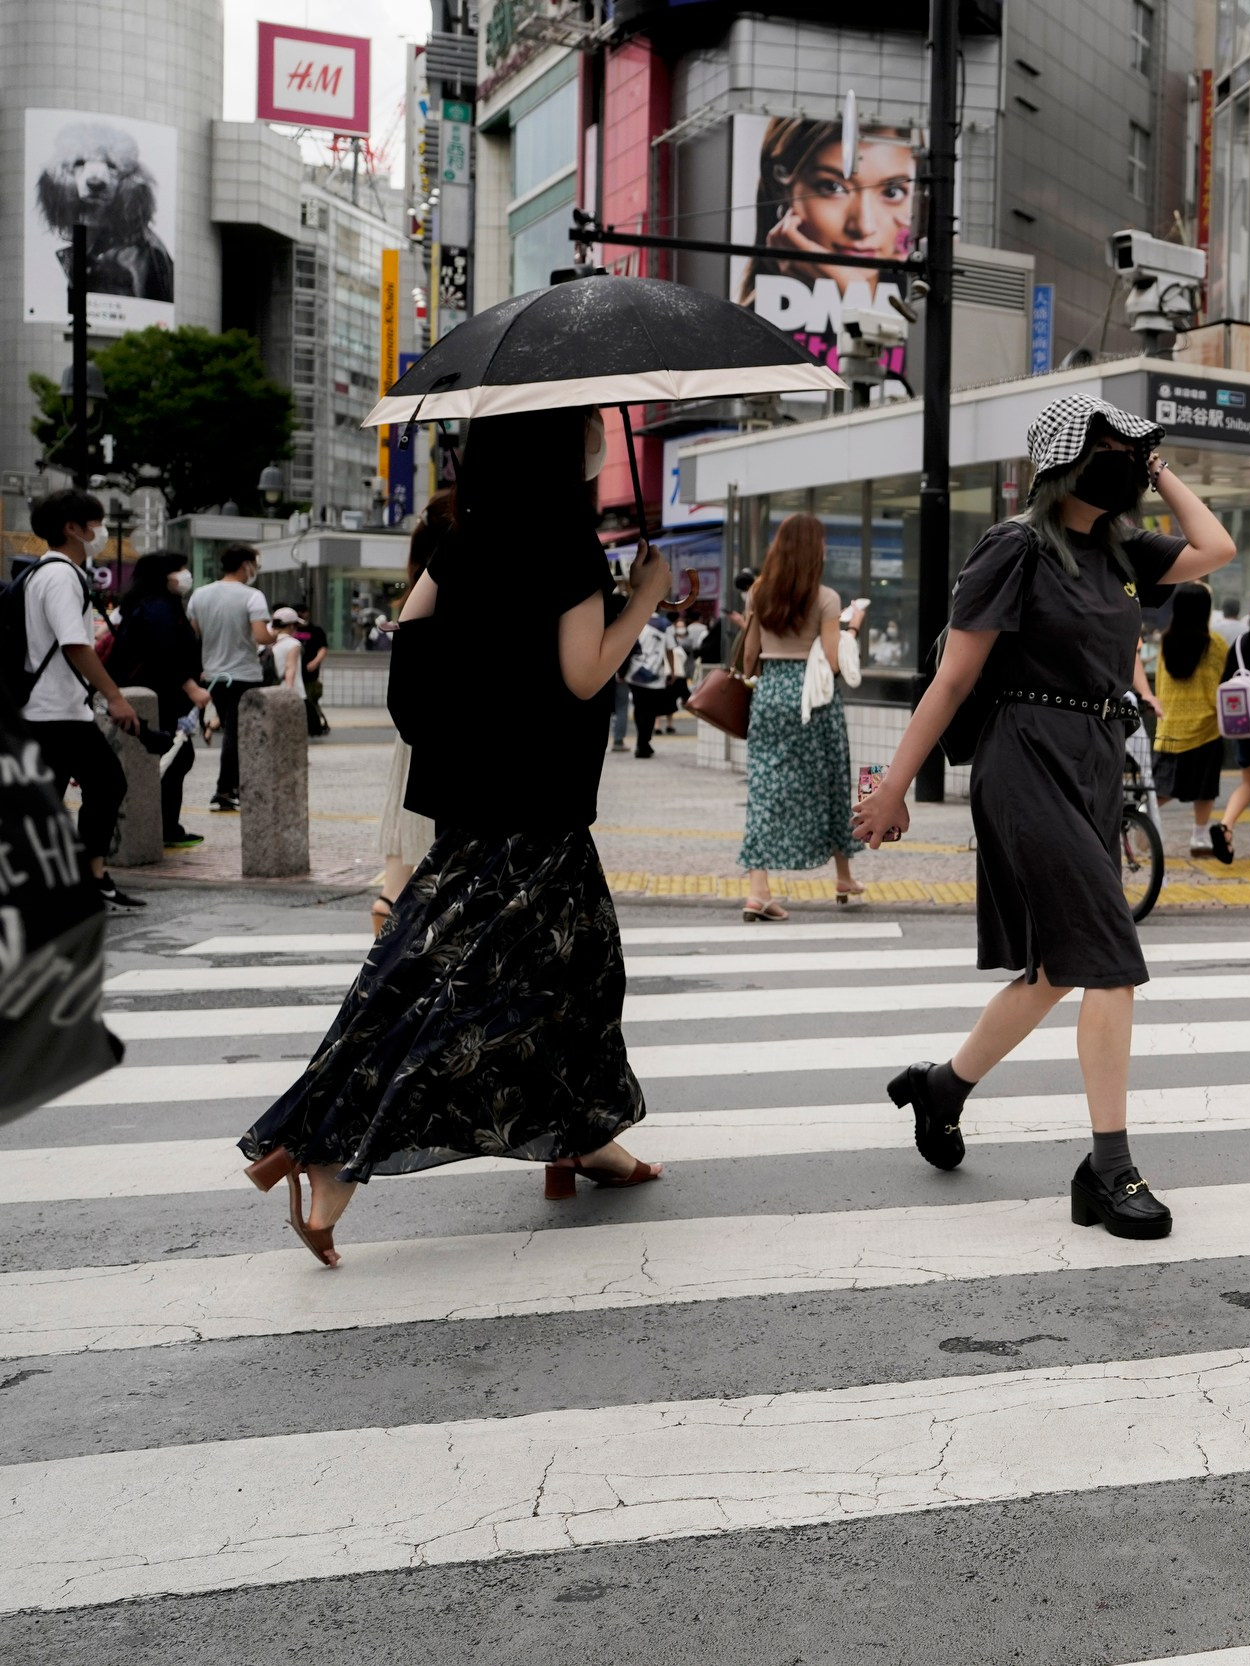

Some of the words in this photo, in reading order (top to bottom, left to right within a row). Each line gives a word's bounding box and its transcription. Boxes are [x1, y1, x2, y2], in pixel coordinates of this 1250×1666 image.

[287, 60, 343, 96] H&M
[1176, 404, 1224, 428] 渋谷駅
